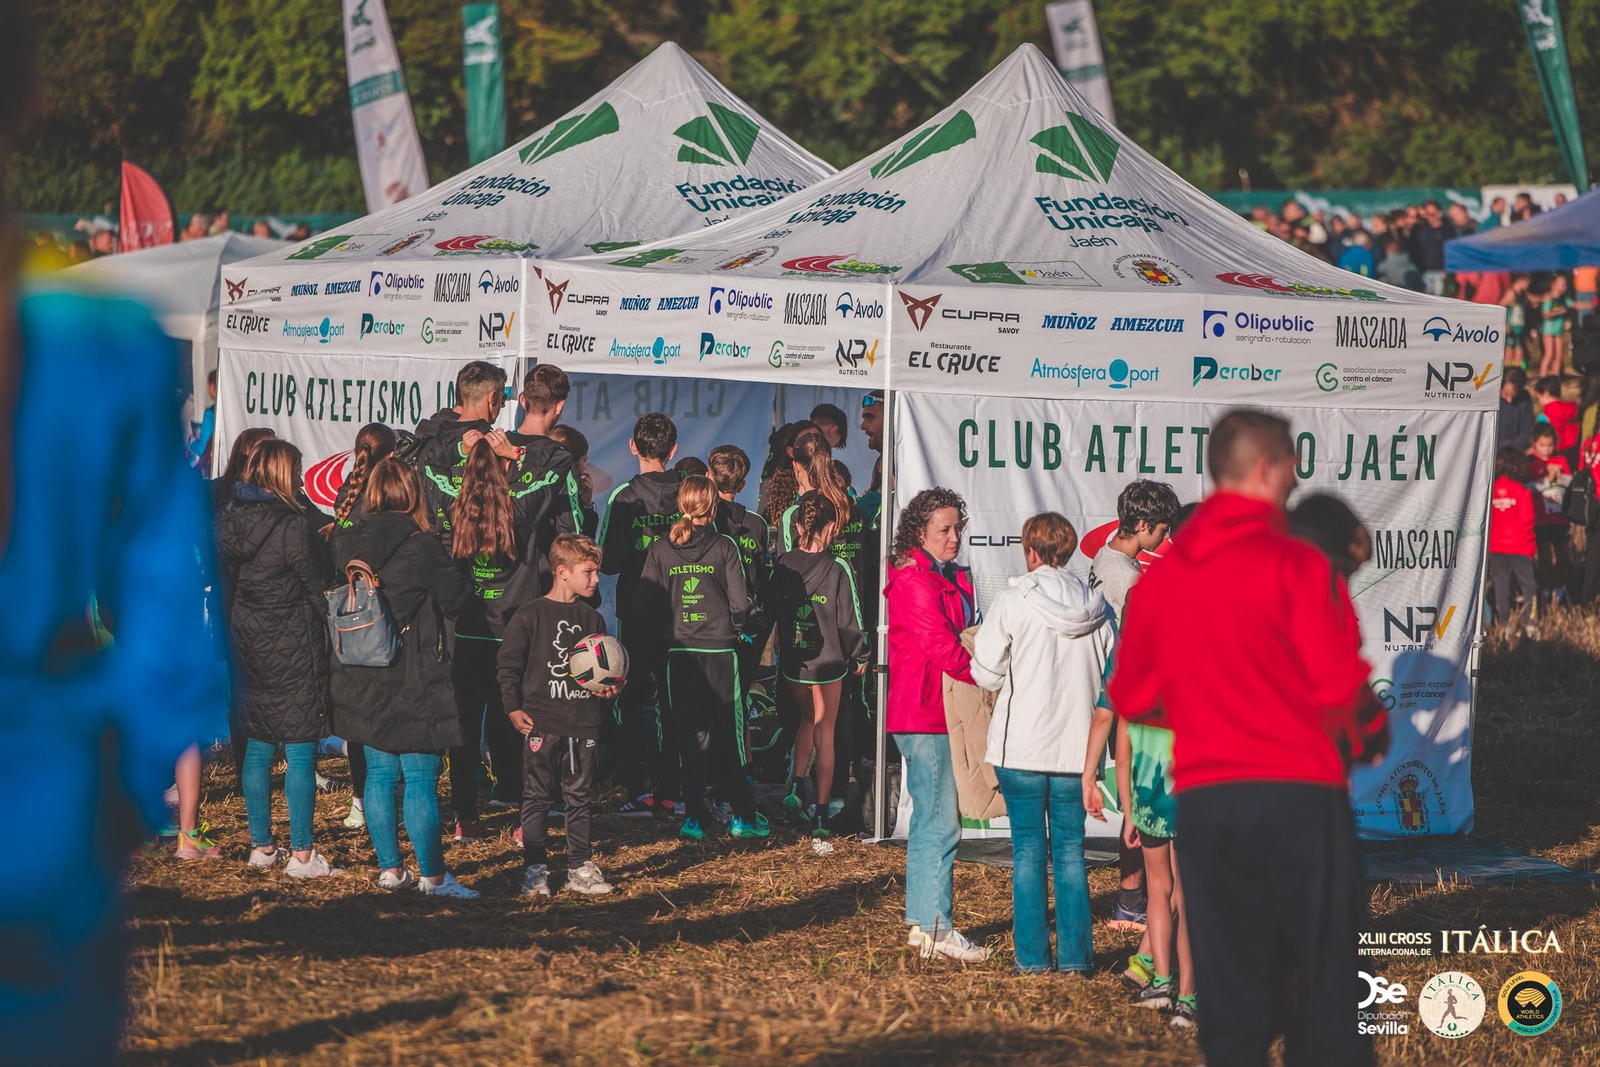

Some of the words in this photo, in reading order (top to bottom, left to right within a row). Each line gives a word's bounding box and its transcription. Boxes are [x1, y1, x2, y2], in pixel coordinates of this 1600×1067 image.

[461, 173, 551, 198] Fundación
[675, 174, 807, 198] Fundació
[442, 190, 505, 210] Unicaja
[807, 187, 906, 214] Fundación
[1034, 193, 1190, 227] Fundación
[786, 205, 857, 226] Unicaja
[1047, 211, 1164, 233] Unicaja
[1070, 235, 1118, 248] Jaén
[291, 282, 318, 297] MUÑOZ
[325, 280, 361, 295] AMEZCUA
[385, 273, 424, 291] Olipublic
[494, 275, 519, 294] Ávolo
[567, 294, 609, 305] CUPRA
[620, 295, 651, 310] MUÑOZ
[657, 296, 699, 310] AMEZCUA
[728, 289, 772, 311] Olipublic
[854, 299, 883, 318] Ávolo
[227, 315, 237, 329] EL
[239, 315, 270, 334] CRUCE
[942, 309, 1020, 323] CUPRA
[1042, 312, 1097, 330] MUÑOZ
[1110, 317, 1184, 333] AMEZCUA
[1235, 312, 1314, 333] Olipublic
[282, 319, 318, 343] Atmósfera
[1336, 316, 1407, 348] MASSADA
[1452, 323, 1499, 343] Ávolo
[547, 333, 559, 349] EL
[562, 333, 596, 354] CRUCE
[609, 337, 650, 364] Atmósfera
[930, 342, 972, 351] Restaurante
[908, 351, 932, 368] EL
[937, 352, 1001, 375] CRUCE
[1031, 358, 1106, 387] Atmósfera
[1378, 367, 1406, 376] española
[246, 371, 297, 417] CLUB
[305, 377, 422, 425] ATLETISMO
[958, 418, 1062, 471] CLUB
[1084, 424, 1316, 480] ATLETO
[1338, 425, 1437, 481] JAÉN
[669, 564, 715, 576] ATLETISMO
[1420, 690, 1446, 698] cáncer
